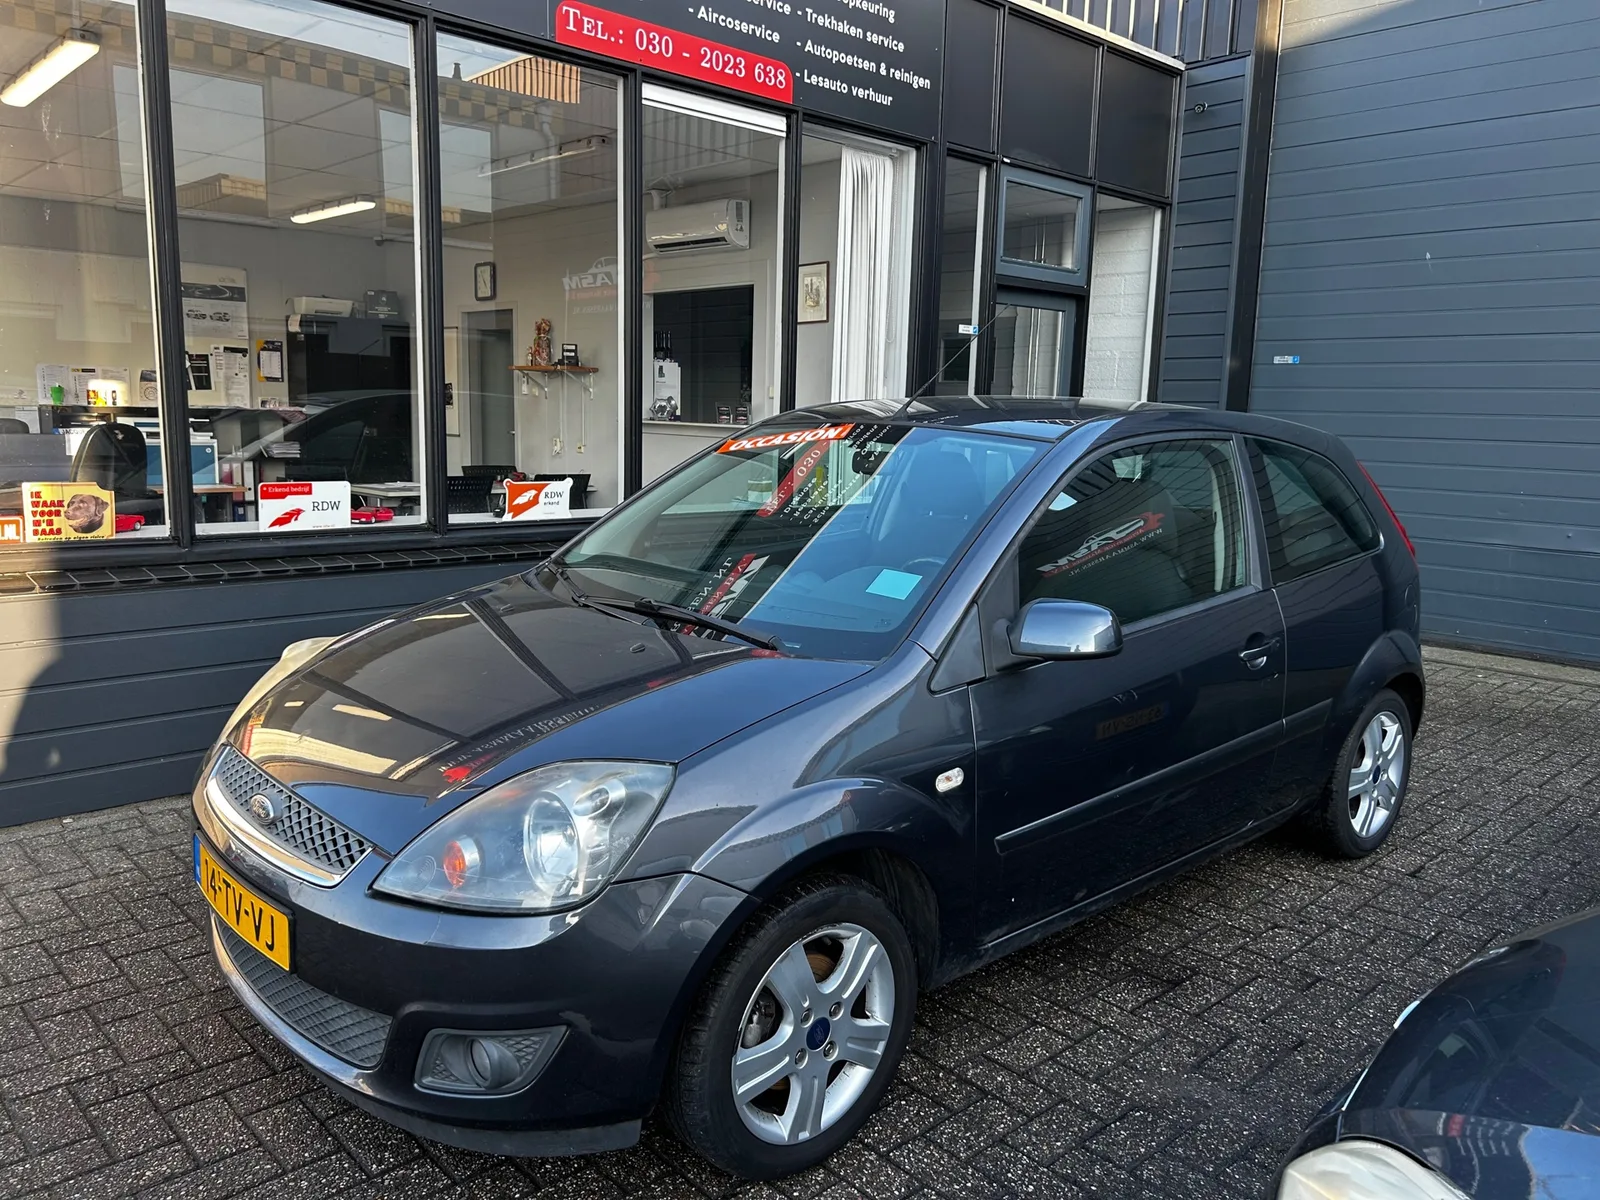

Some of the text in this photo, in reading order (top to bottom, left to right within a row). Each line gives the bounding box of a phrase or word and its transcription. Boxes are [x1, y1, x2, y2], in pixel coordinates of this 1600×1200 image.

[697, 6, 781, 44] Aircoservice
[805, 8, 905, 53] Trekhaken service
[635, 28, 674, 59] 030
[700, 46, 747, 79] 2023
[754, 60, 787, 90] 638
[804, 40, 932, 91] Autopoetsen & reinigen
[804, 69, 894, 107] Lesauto verhuur
[290, 485, 310, 493] bedrijf
[30, 491, 42, 499] IK
[544, 491, 564, 499] RDW
[31, 500, 65, 508] WAAK
[312, 501, 341, 512] RDW
[31, 509, 62, 518] VOOR
[32, 519, 54, 527] M'N
[33, 528, 62, 536] BAAS
[205, 858, 275, 951] 14-TV-VJ
